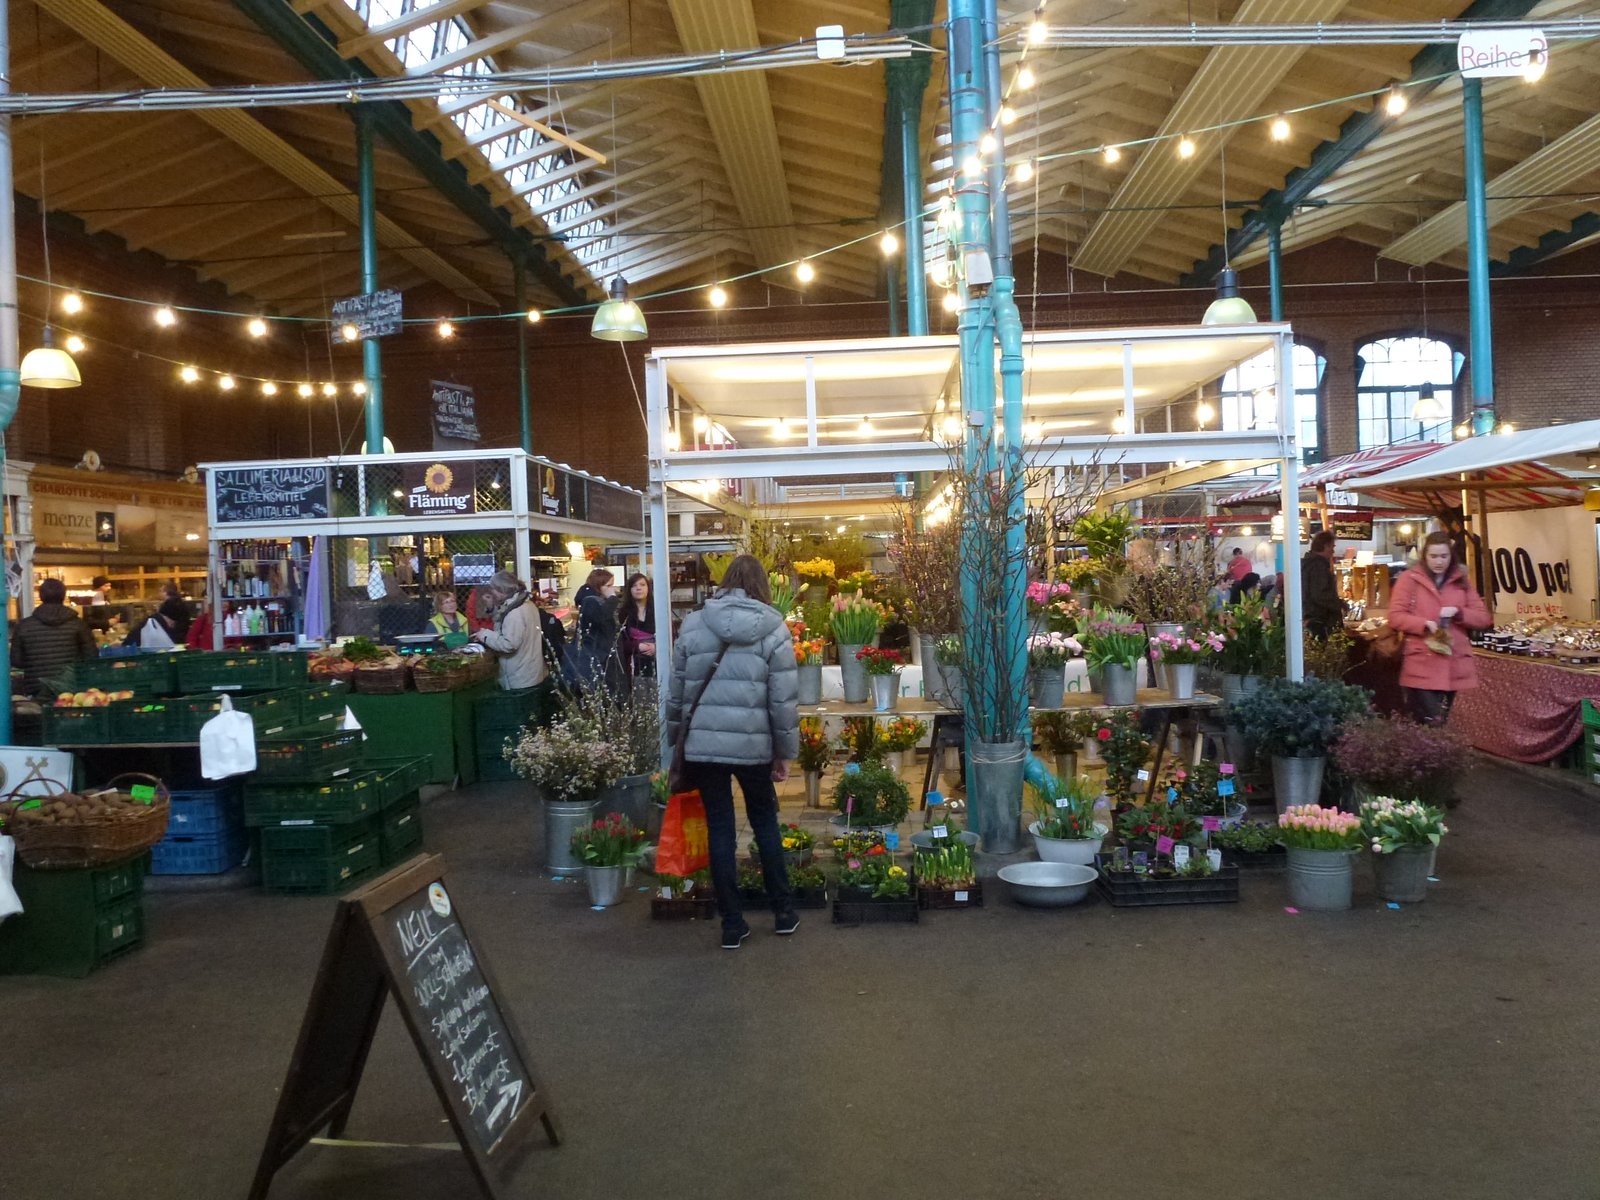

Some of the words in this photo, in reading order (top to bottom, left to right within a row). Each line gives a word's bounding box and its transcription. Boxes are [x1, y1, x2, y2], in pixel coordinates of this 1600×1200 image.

[1461, 44, 1522, 69] Reihe
[218, 469, 291, 488] SALUMERIA
[304, 467, 326, 484] SUD
[234, 492, 306, 504] LEBENSMITTEL
[408, 493, 471, 510] Fläming
[43, 511, 93, 528] menze
[1516, 602, 1542, 614] Gute
